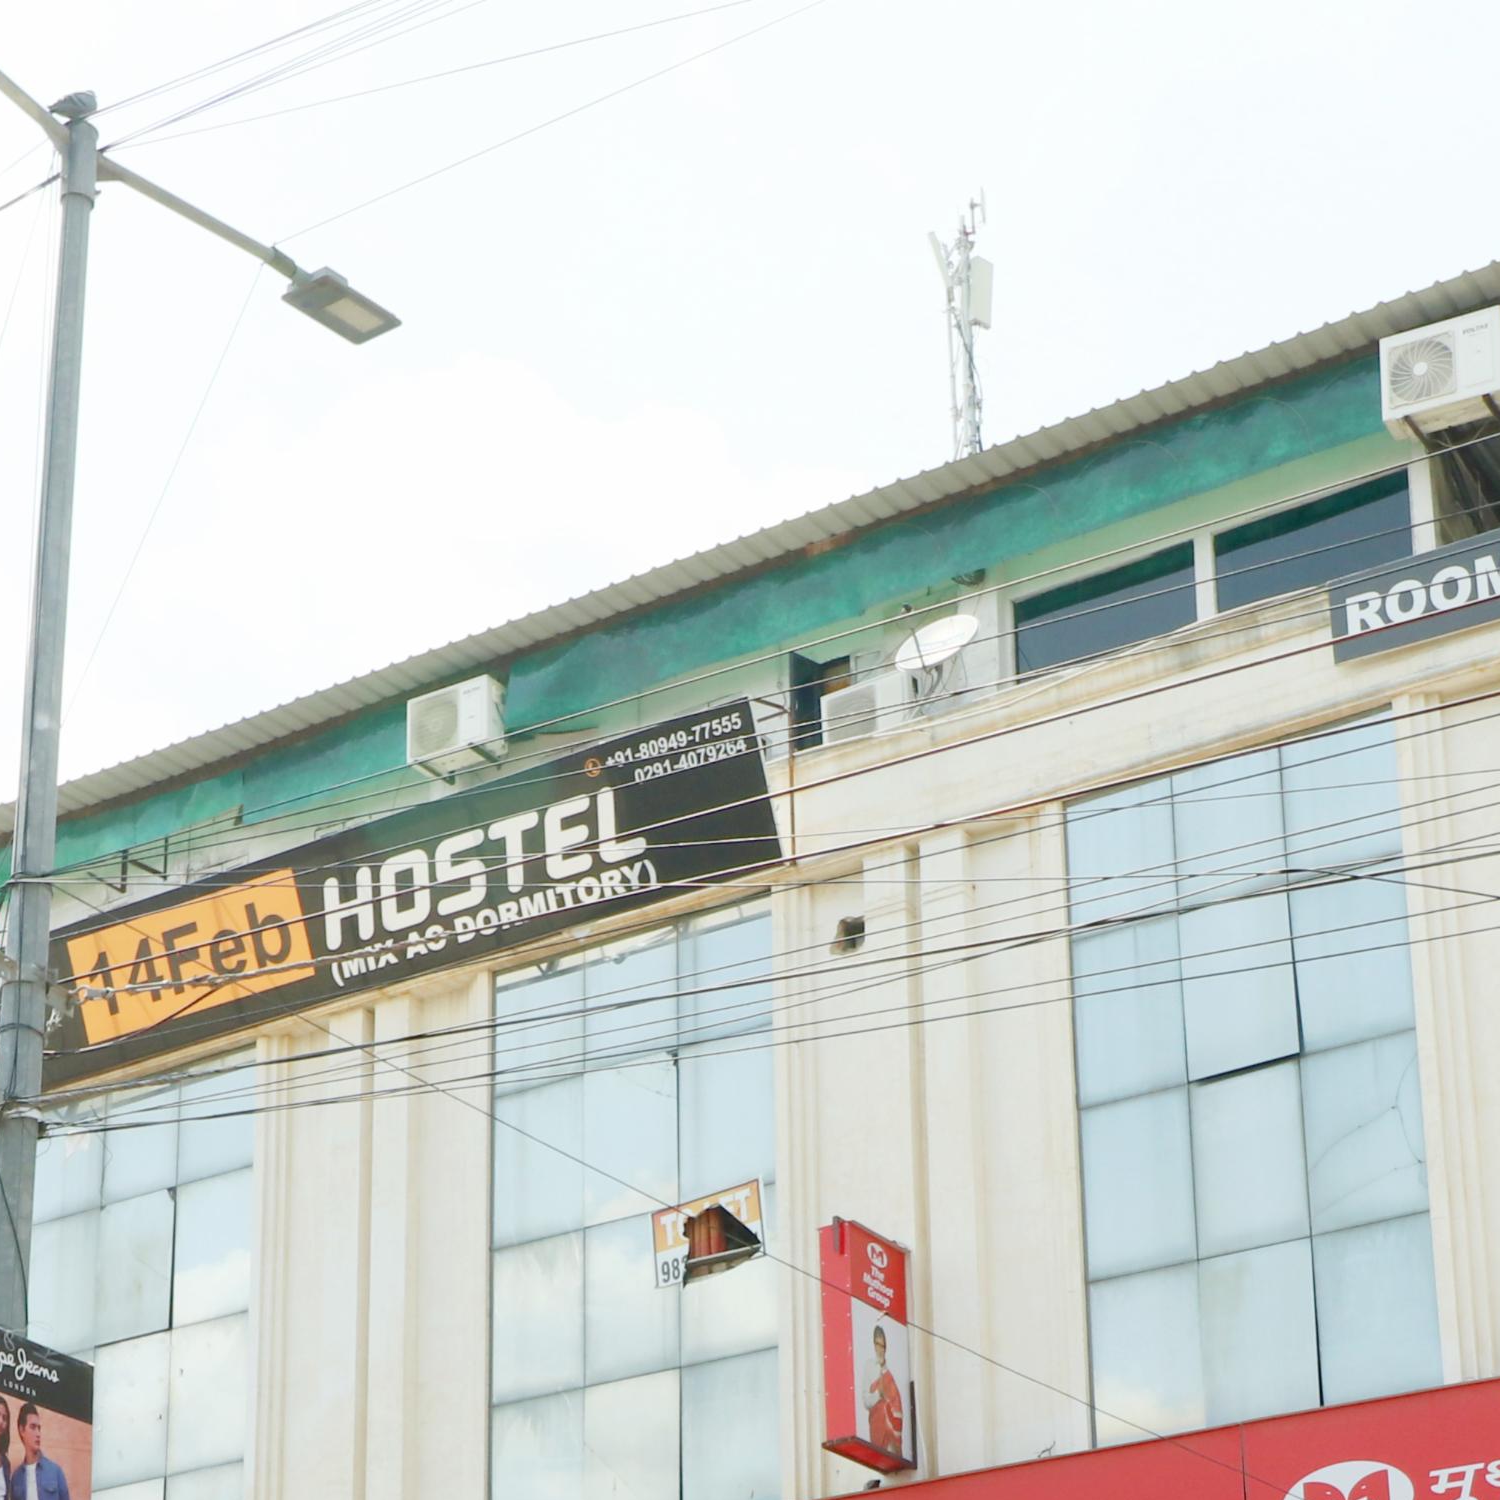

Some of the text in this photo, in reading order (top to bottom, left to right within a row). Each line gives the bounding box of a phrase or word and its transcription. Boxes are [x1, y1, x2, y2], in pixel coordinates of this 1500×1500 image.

[605, 712, 743, 768] +91-80949-77555
[323, 786, 648, 950] HOSTEL
[86, 901, 293, 1016] 14Feb
[330, 935, 399, 987] (MIX
[453, 858, 658, 945] DORMITORY)
[3, 1379, 37, 1397] LONDON
[14, 1348, 60, 1383] Jeans
